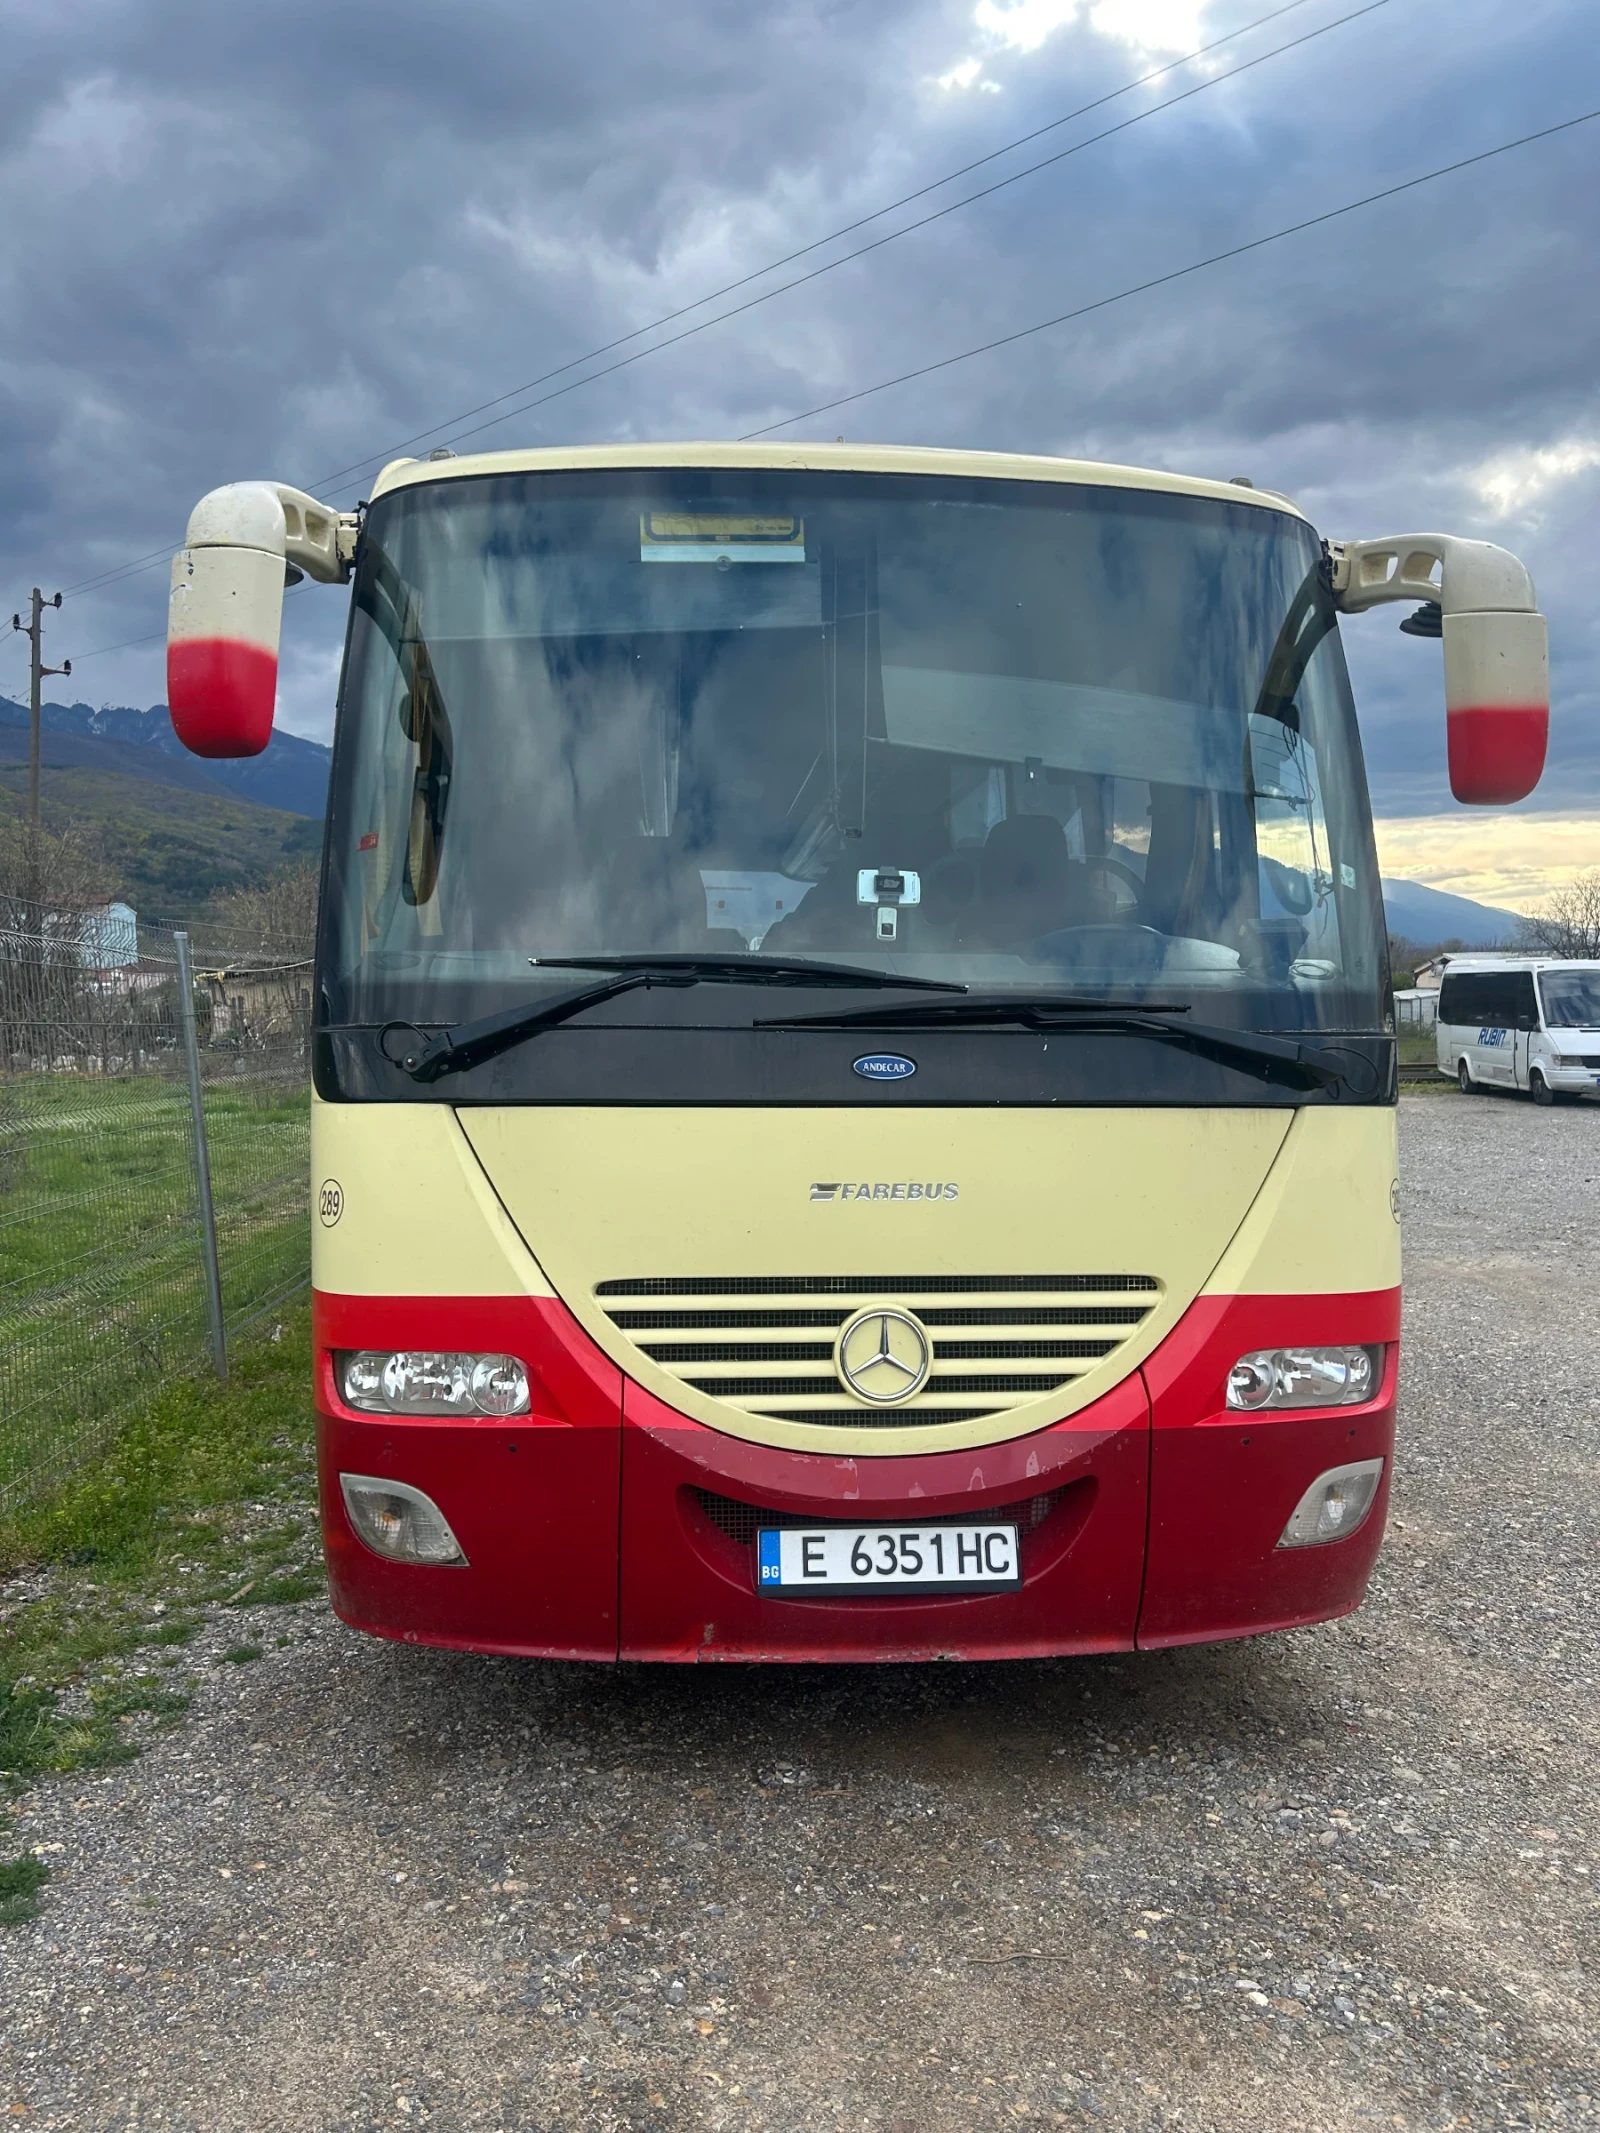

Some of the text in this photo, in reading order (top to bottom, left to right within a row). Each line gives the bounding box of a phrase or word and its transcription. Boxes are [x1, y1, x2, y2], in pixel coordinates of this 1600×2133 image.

[862, 1062, 906, 1073] ANDECAR
[841, 1182, 959, 1201] FAREBUS
[321, 1190, 340, 1216] 289
[762, 1565, 779, 1579] BG
